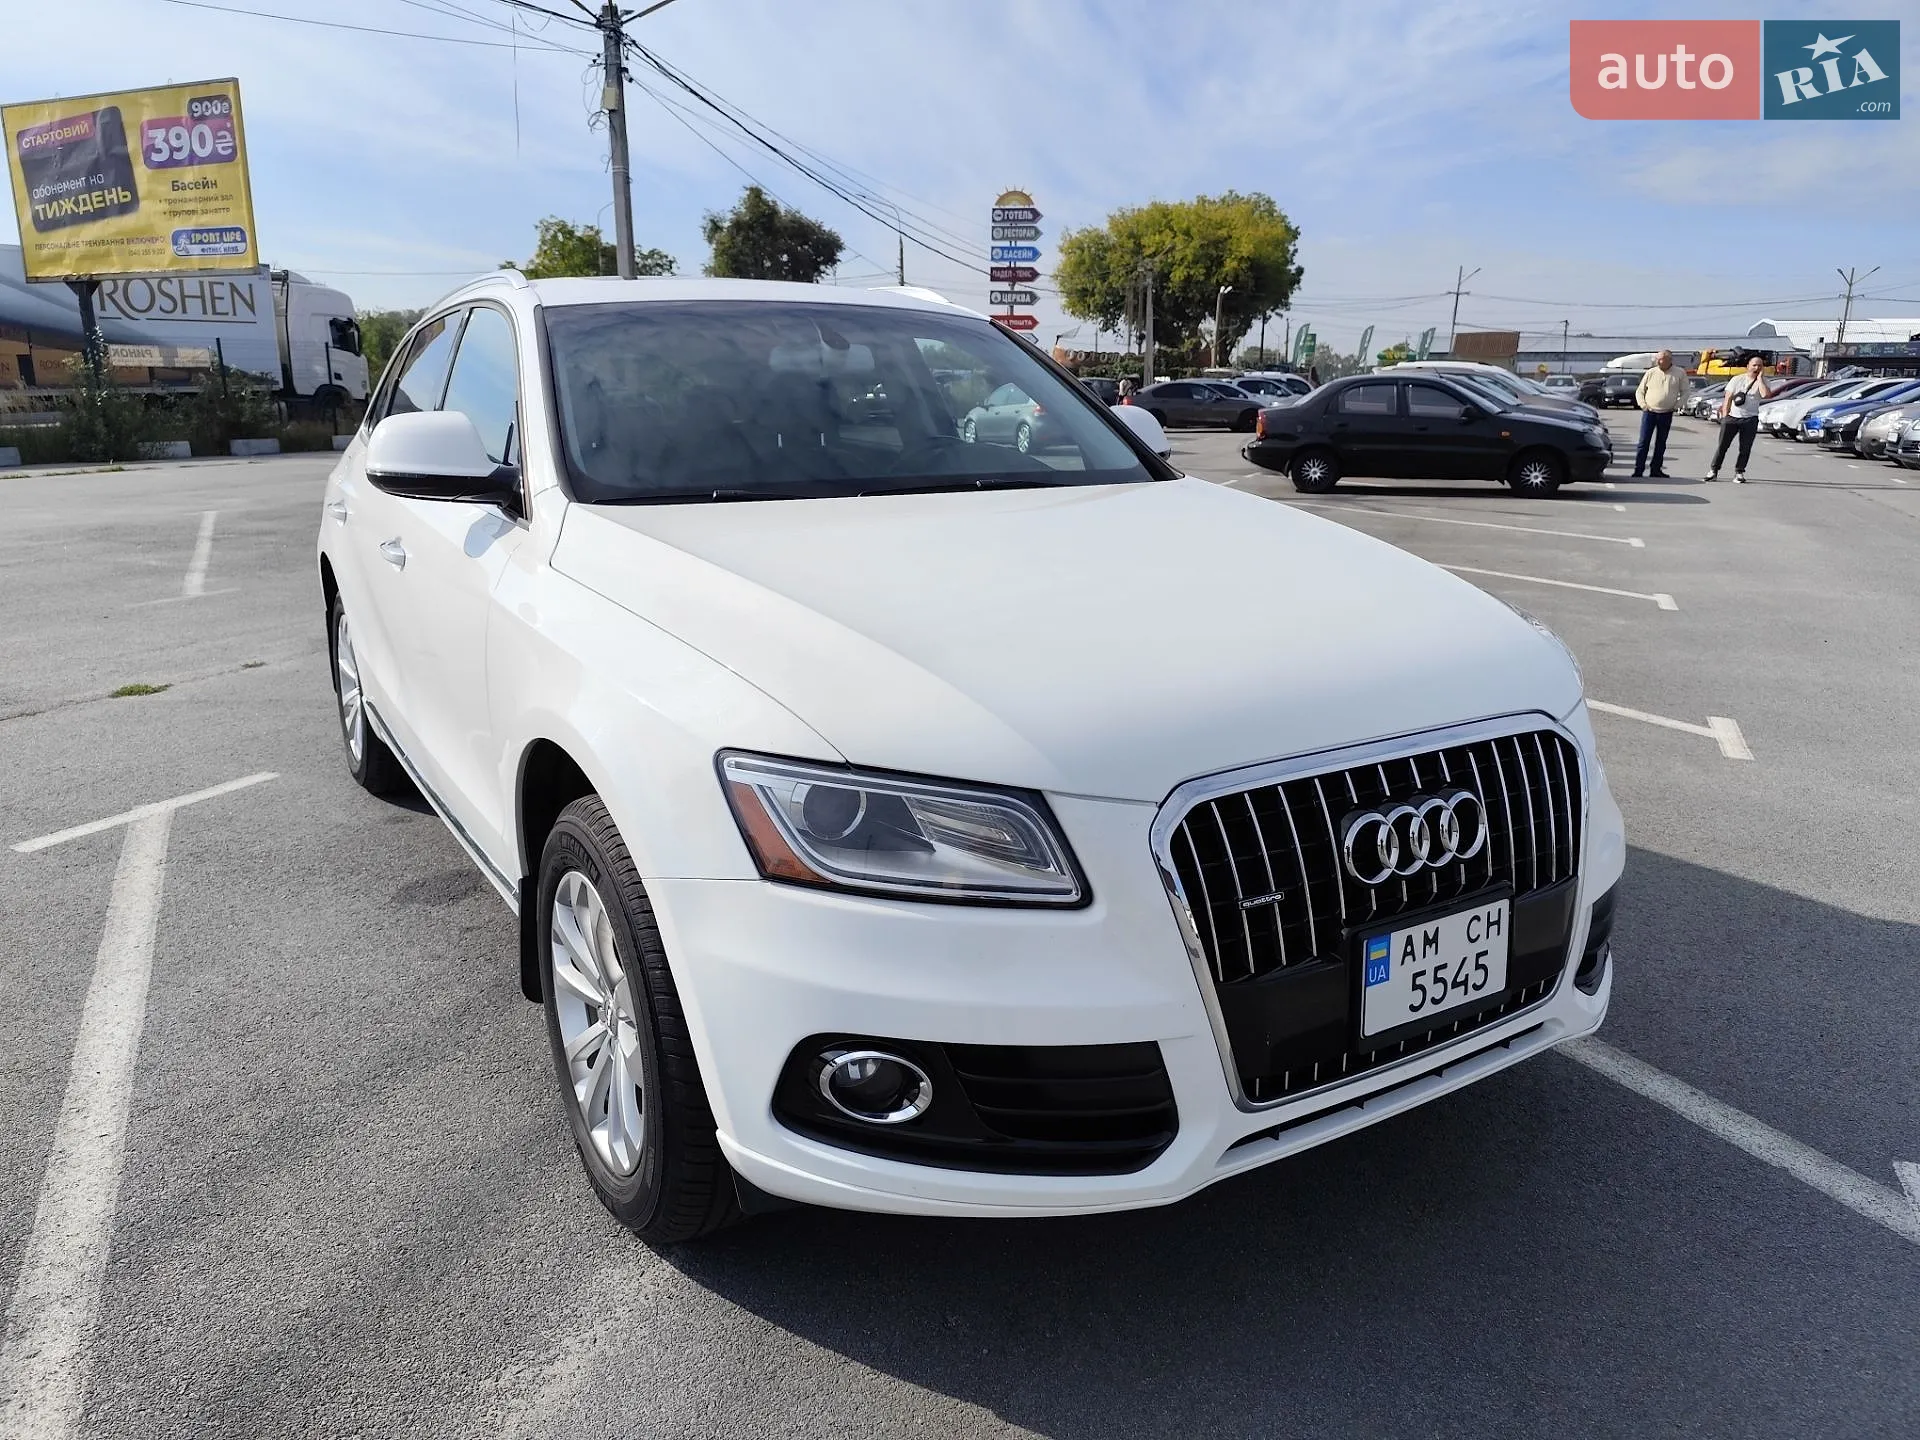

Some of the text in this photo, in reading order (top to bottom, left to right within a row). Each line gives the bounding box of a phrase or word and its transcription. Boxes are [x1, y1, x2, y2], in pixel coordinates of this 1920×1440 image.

[22, 121, 89, 148] СТАРТОВИЙ
[32, 173, 105, 199] абонемент на
[171, 177, 218, 191] Басейн
[35, 186, 131, 220] ТИЖДЕНЬ
[1004, 210, 1033, 220] ГОТЕЛЬ
[191, 231, 241, 243] SPORT LIFE
[1003, 228, 1035, 238] РЕСТОРАН
[1003, 248, 1033, 259] БАСЕЙН
[98, 279, 257, 320] ROSHEN
[1002, 293, 1031, 303] ЦЕРКВА
[1242, 894, 1282, 908] quattro
[1400, 908, 1502, 966] AM CH
[1368, 966, 1387, 984] UA
[1408, 950, 1490, 1013] 5545
